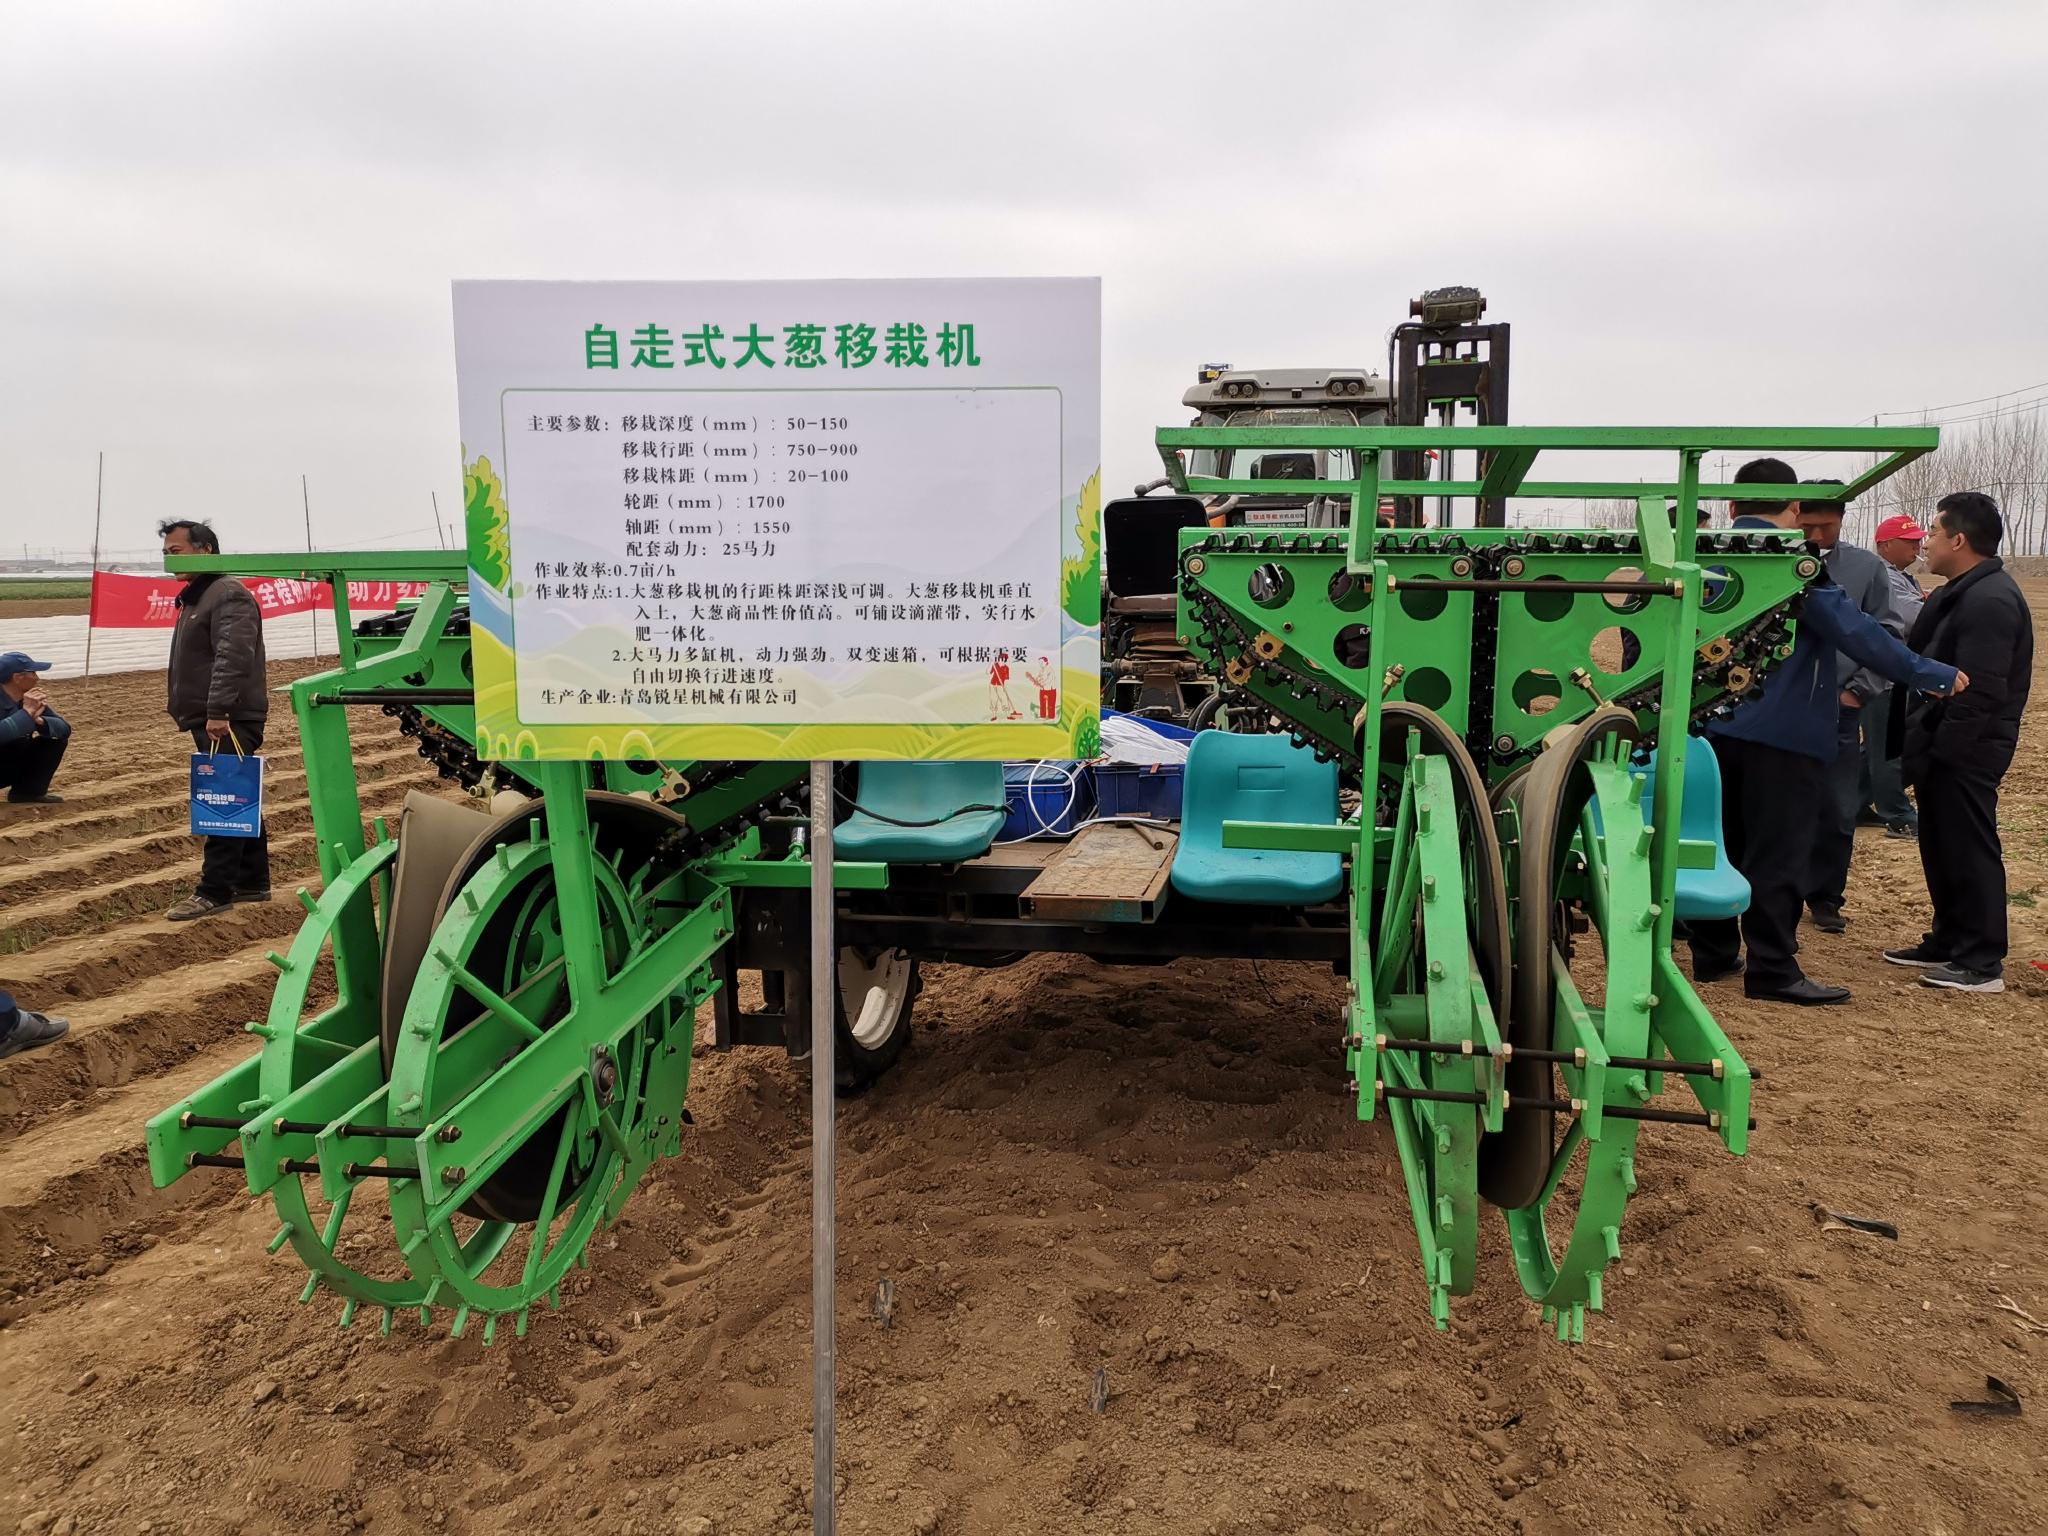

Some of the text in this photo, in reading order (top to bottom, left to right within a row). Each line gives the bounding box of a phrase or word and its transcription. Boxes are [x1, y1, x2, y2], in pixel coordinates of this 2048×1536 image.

[584, 322, 981, 369] 自走式大葱移栽机
[635, 626, 715, 642] 肥一体化。
[633, 667, 785, 685] 自由切换行进速度。
